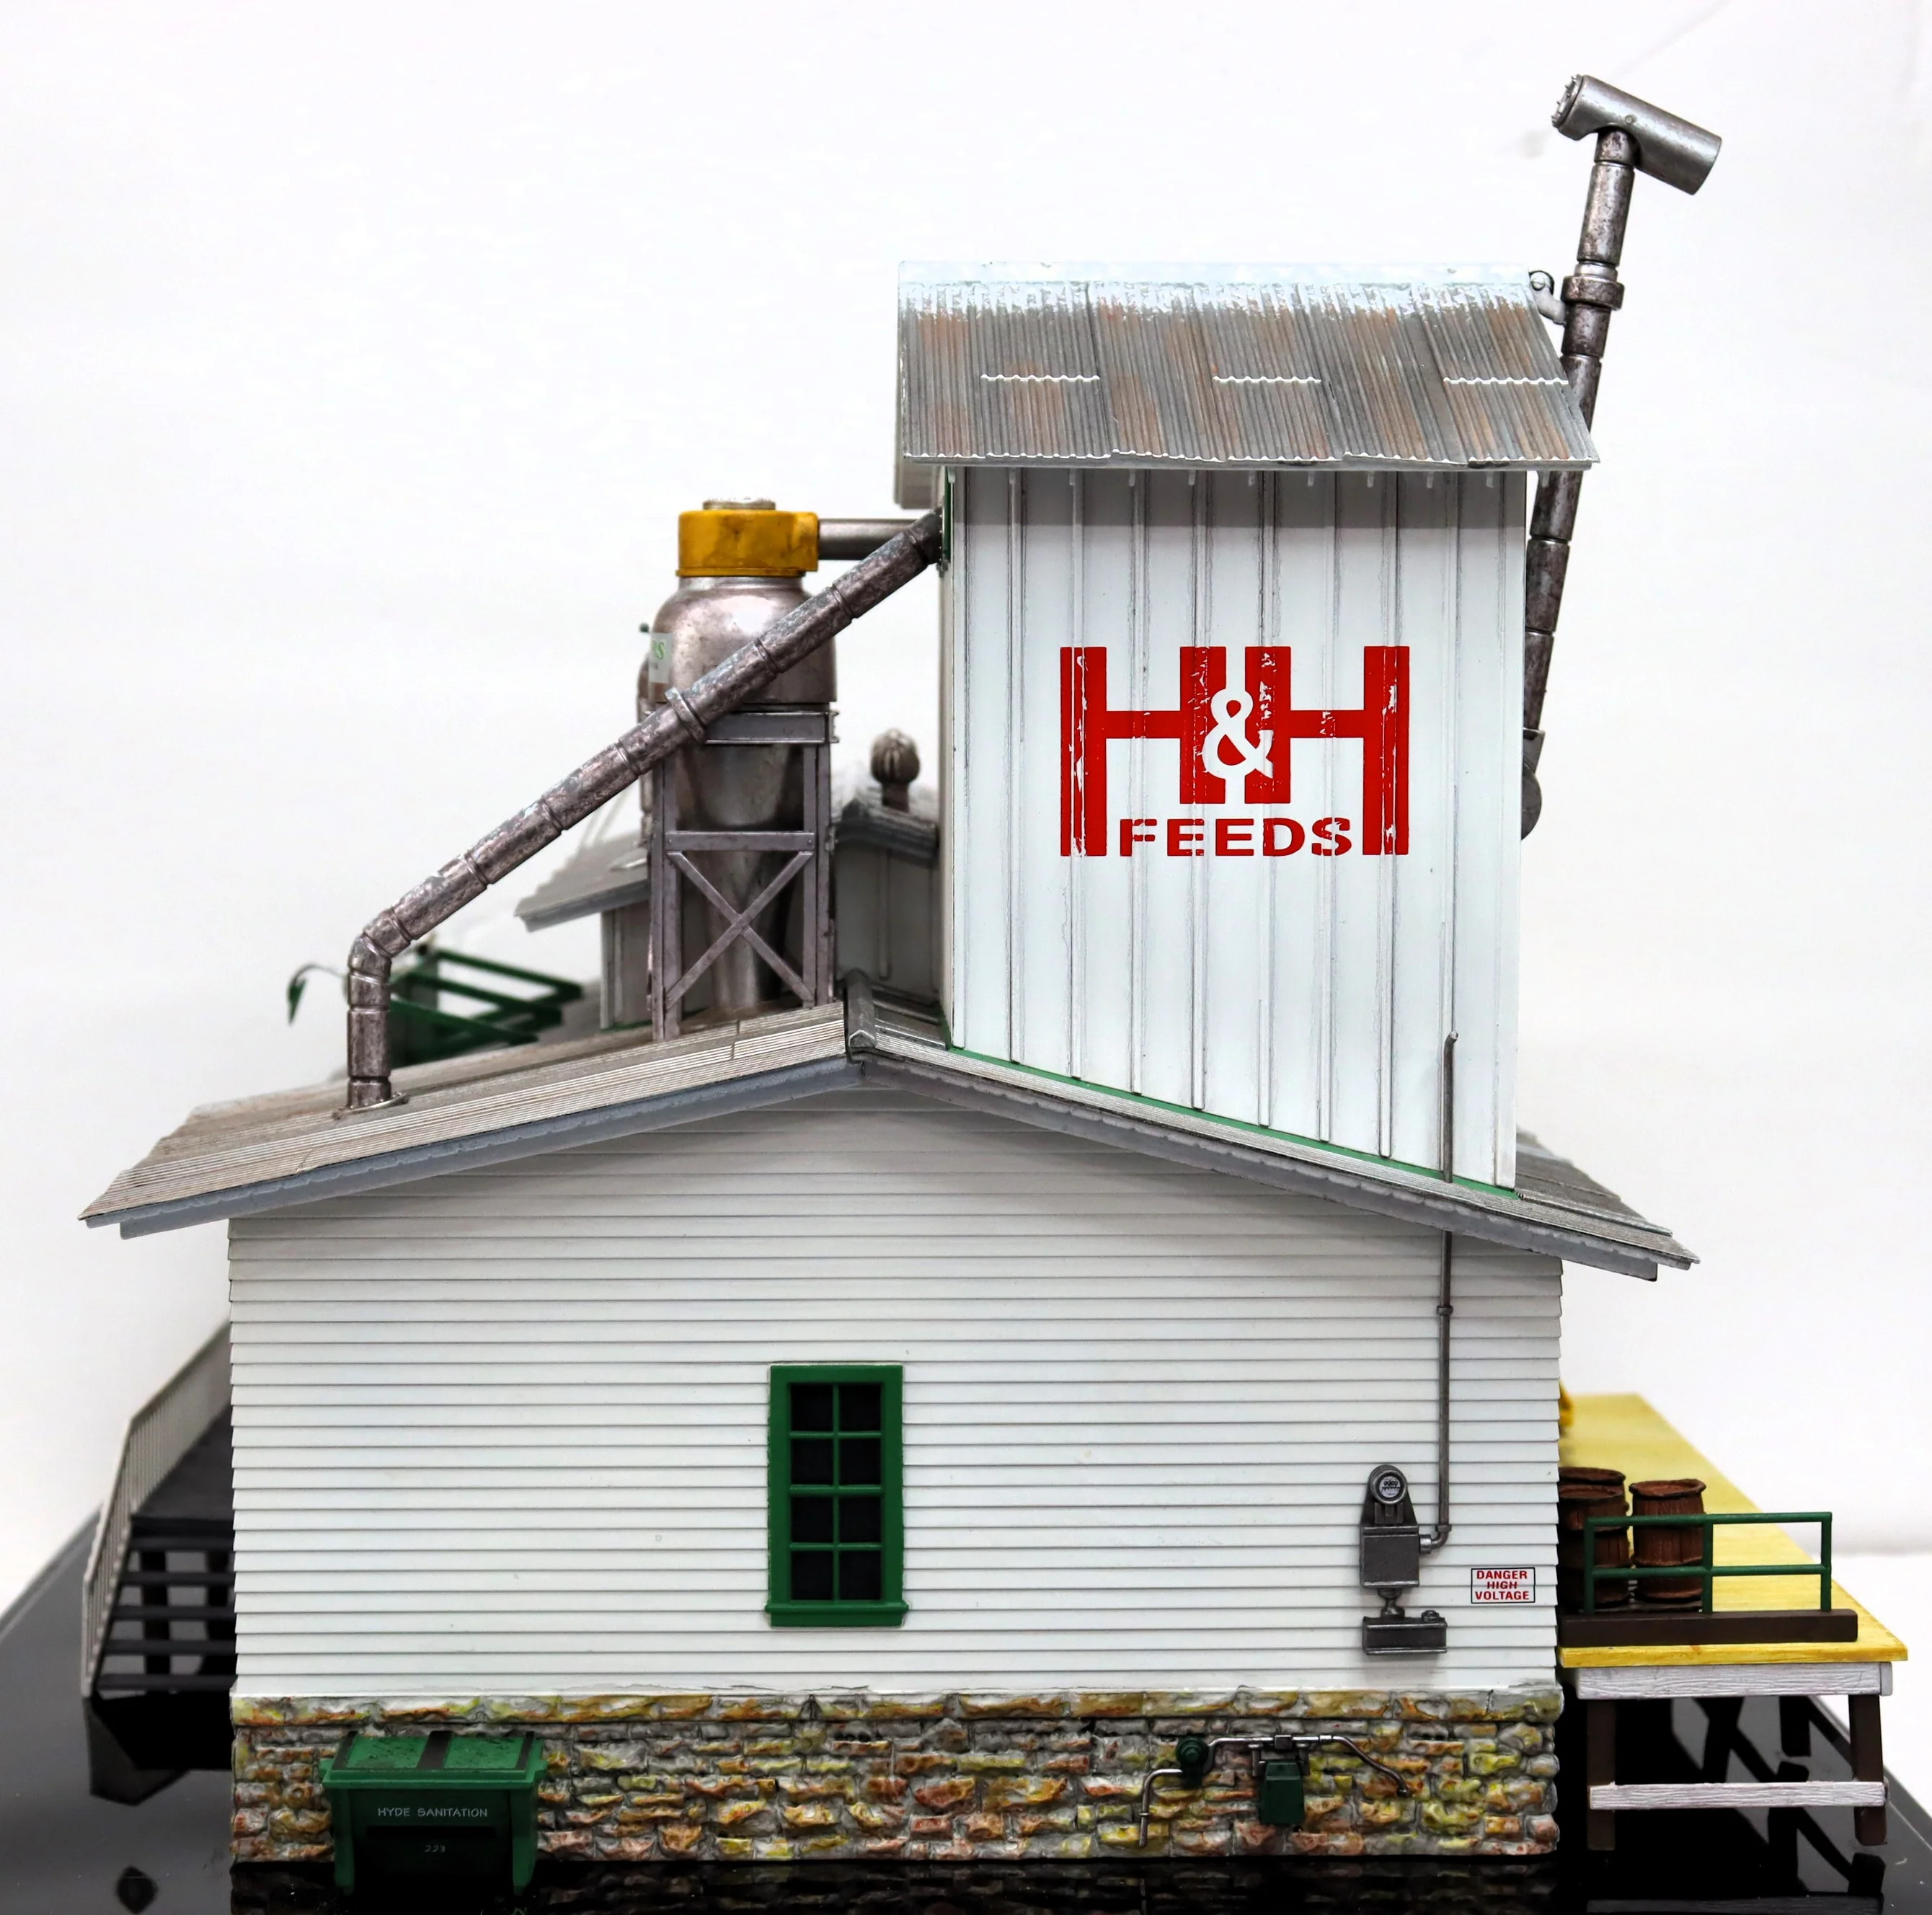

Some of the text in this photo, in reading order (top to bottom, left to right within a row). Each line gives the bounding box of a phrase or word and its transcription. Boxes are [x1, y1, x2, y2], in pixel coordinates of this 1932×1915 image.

[1060, 645, 1411, 857] H&H
[1120, 817, 1353, 857] FEEDS
[1476, 1570, 1528, 1580] DANGER
[1486, 1580, 1518, 1590] HIGH
[1475, 1591, 1530, 1601] VOLTAGE
[378, 1808, 487, 1818] HYDE SANITATION
